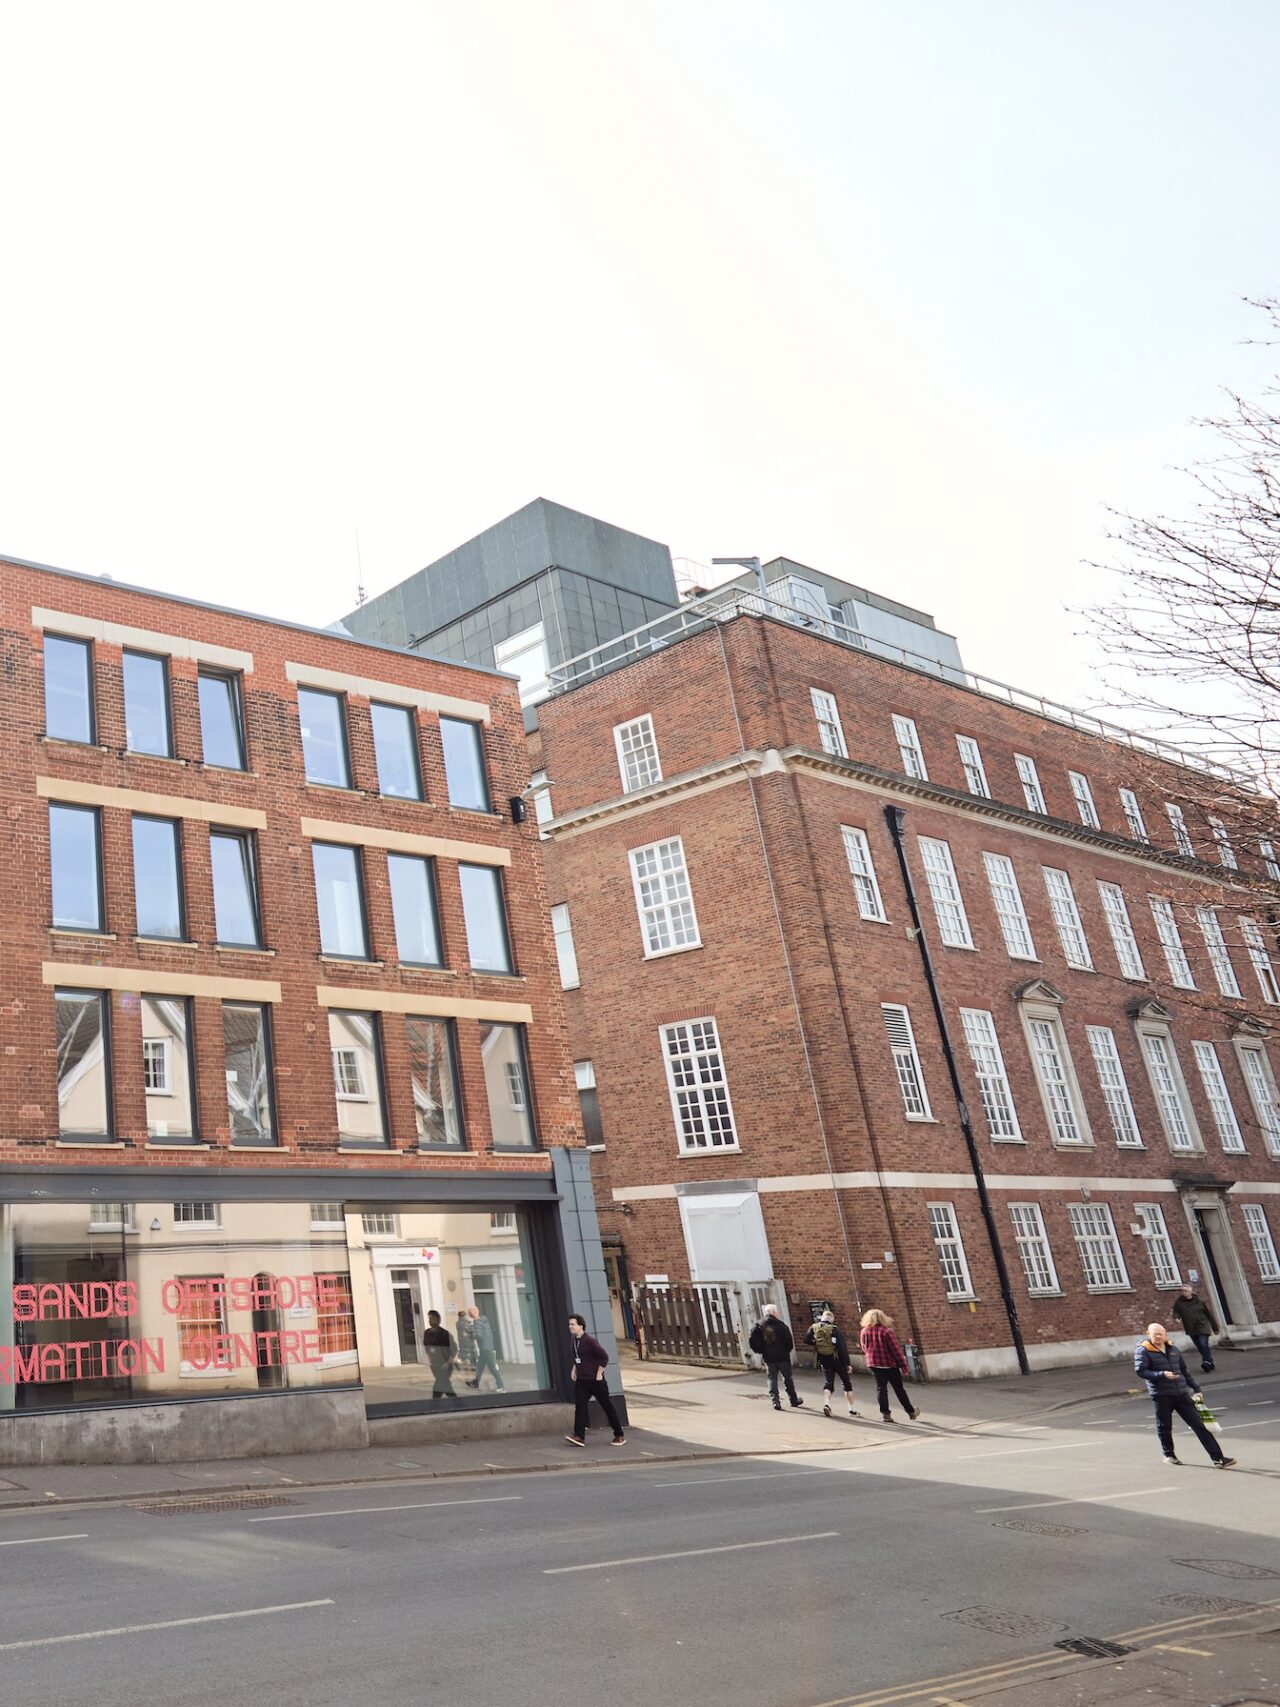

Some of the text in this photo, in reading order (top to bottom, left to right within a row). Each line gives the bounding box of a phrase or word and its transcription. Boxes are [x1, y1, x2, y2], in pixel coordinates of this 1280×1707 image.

[13, 1280, 138, 1322] SANDS
[161, 1274, 340, 1316] OFFSHORE
[186, 1329, 324, 1372] CENTRE
